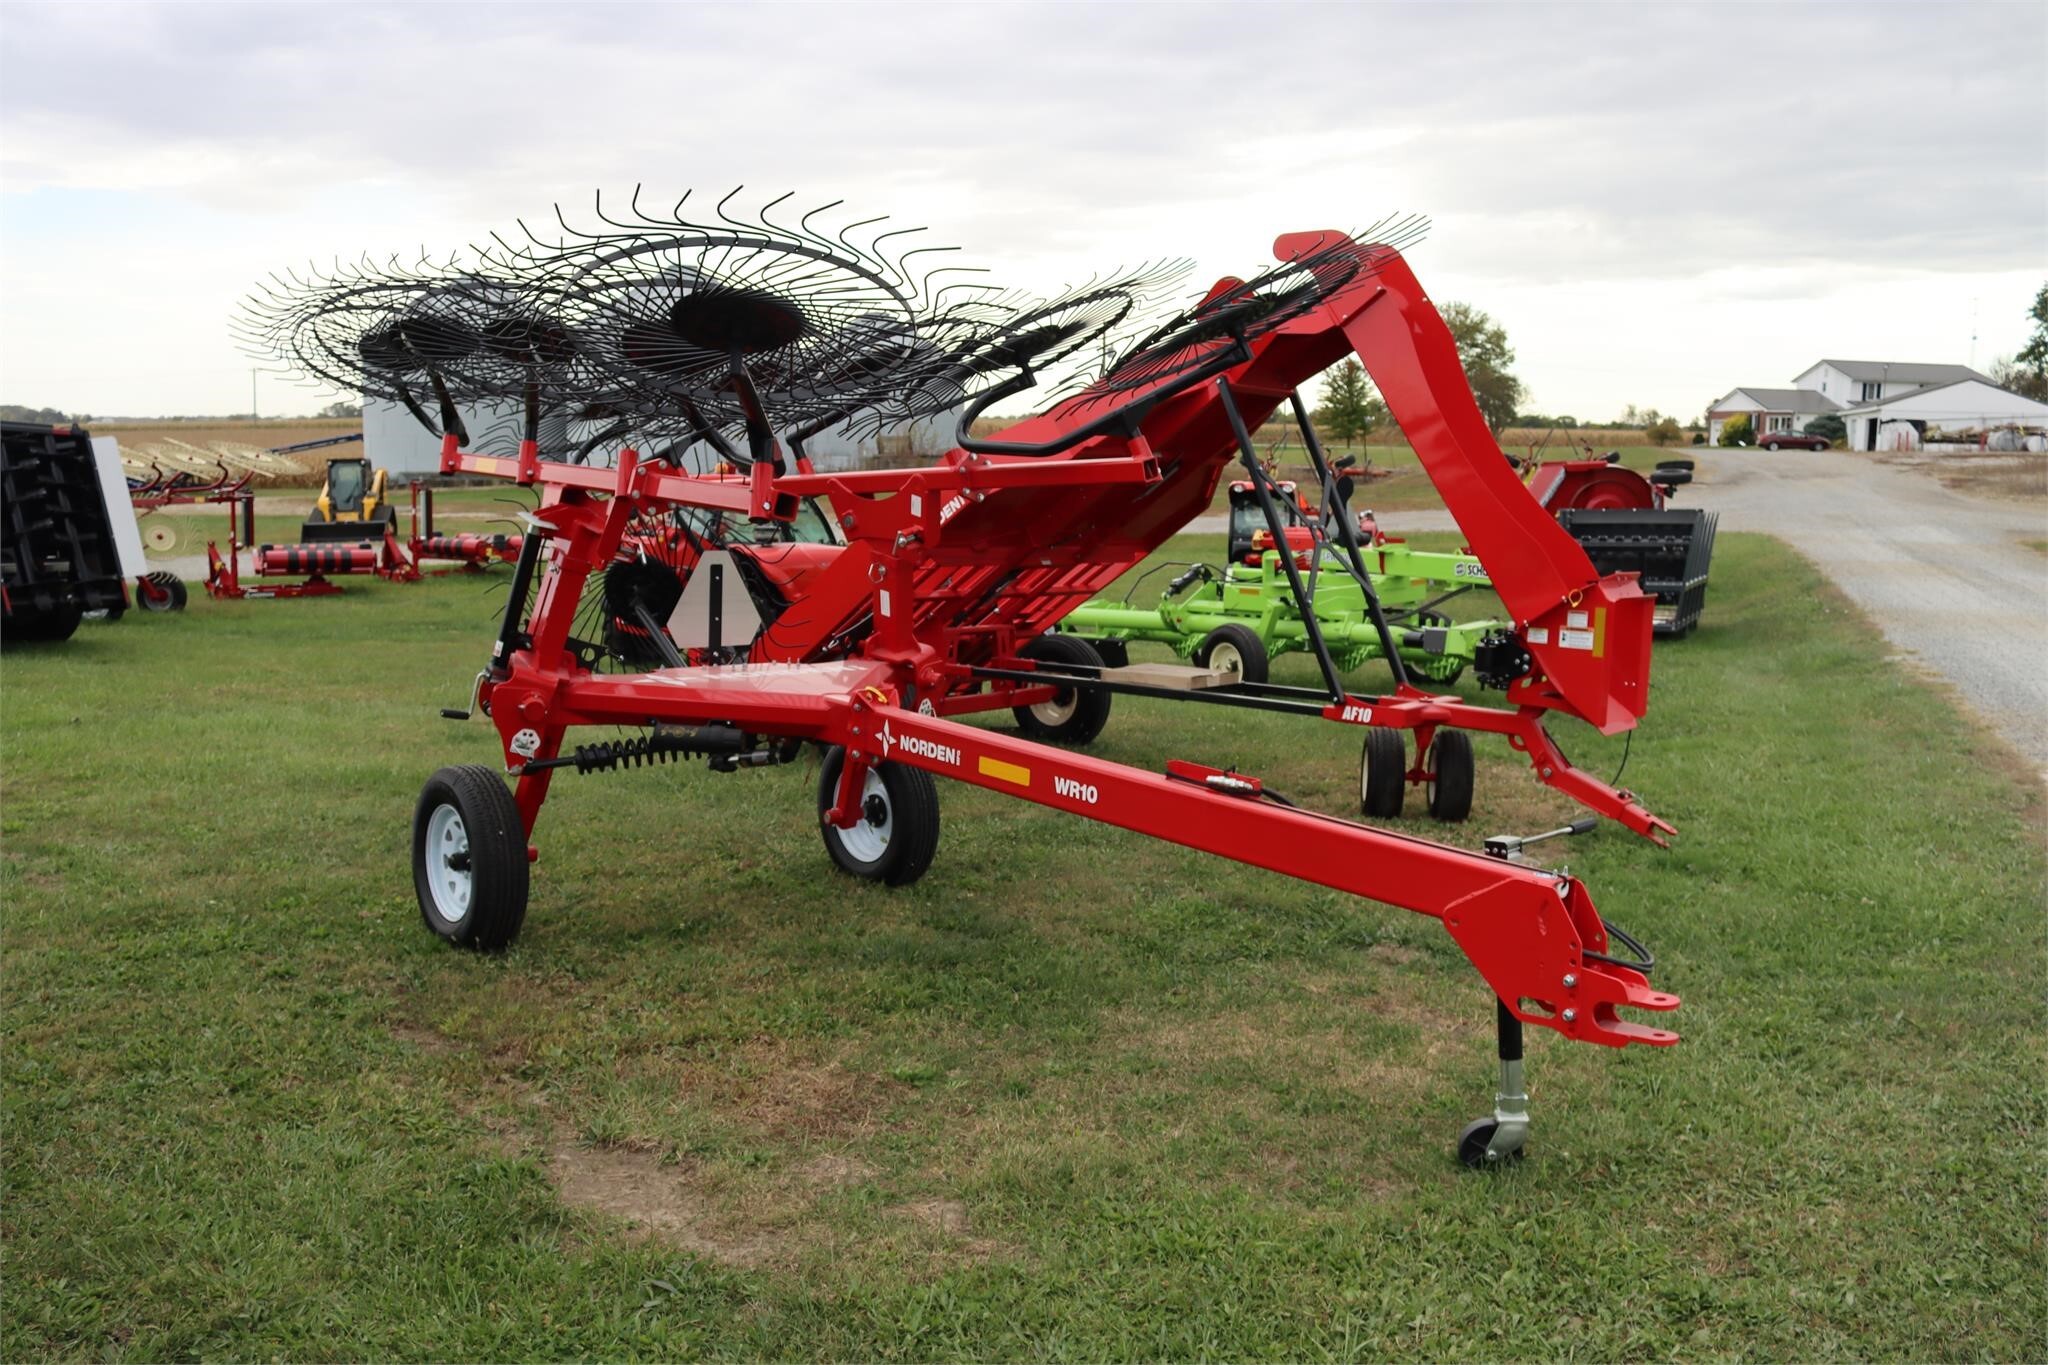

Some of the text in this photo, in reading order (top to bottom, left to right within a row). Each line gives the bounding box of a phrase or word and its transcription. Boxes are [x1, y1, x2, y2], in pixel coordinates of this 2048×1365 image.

[1341, 705, 1373, 723] AF10
[900, 734, 956, 765] NORDEN
[1054, 775, 1098, 804] WR10
